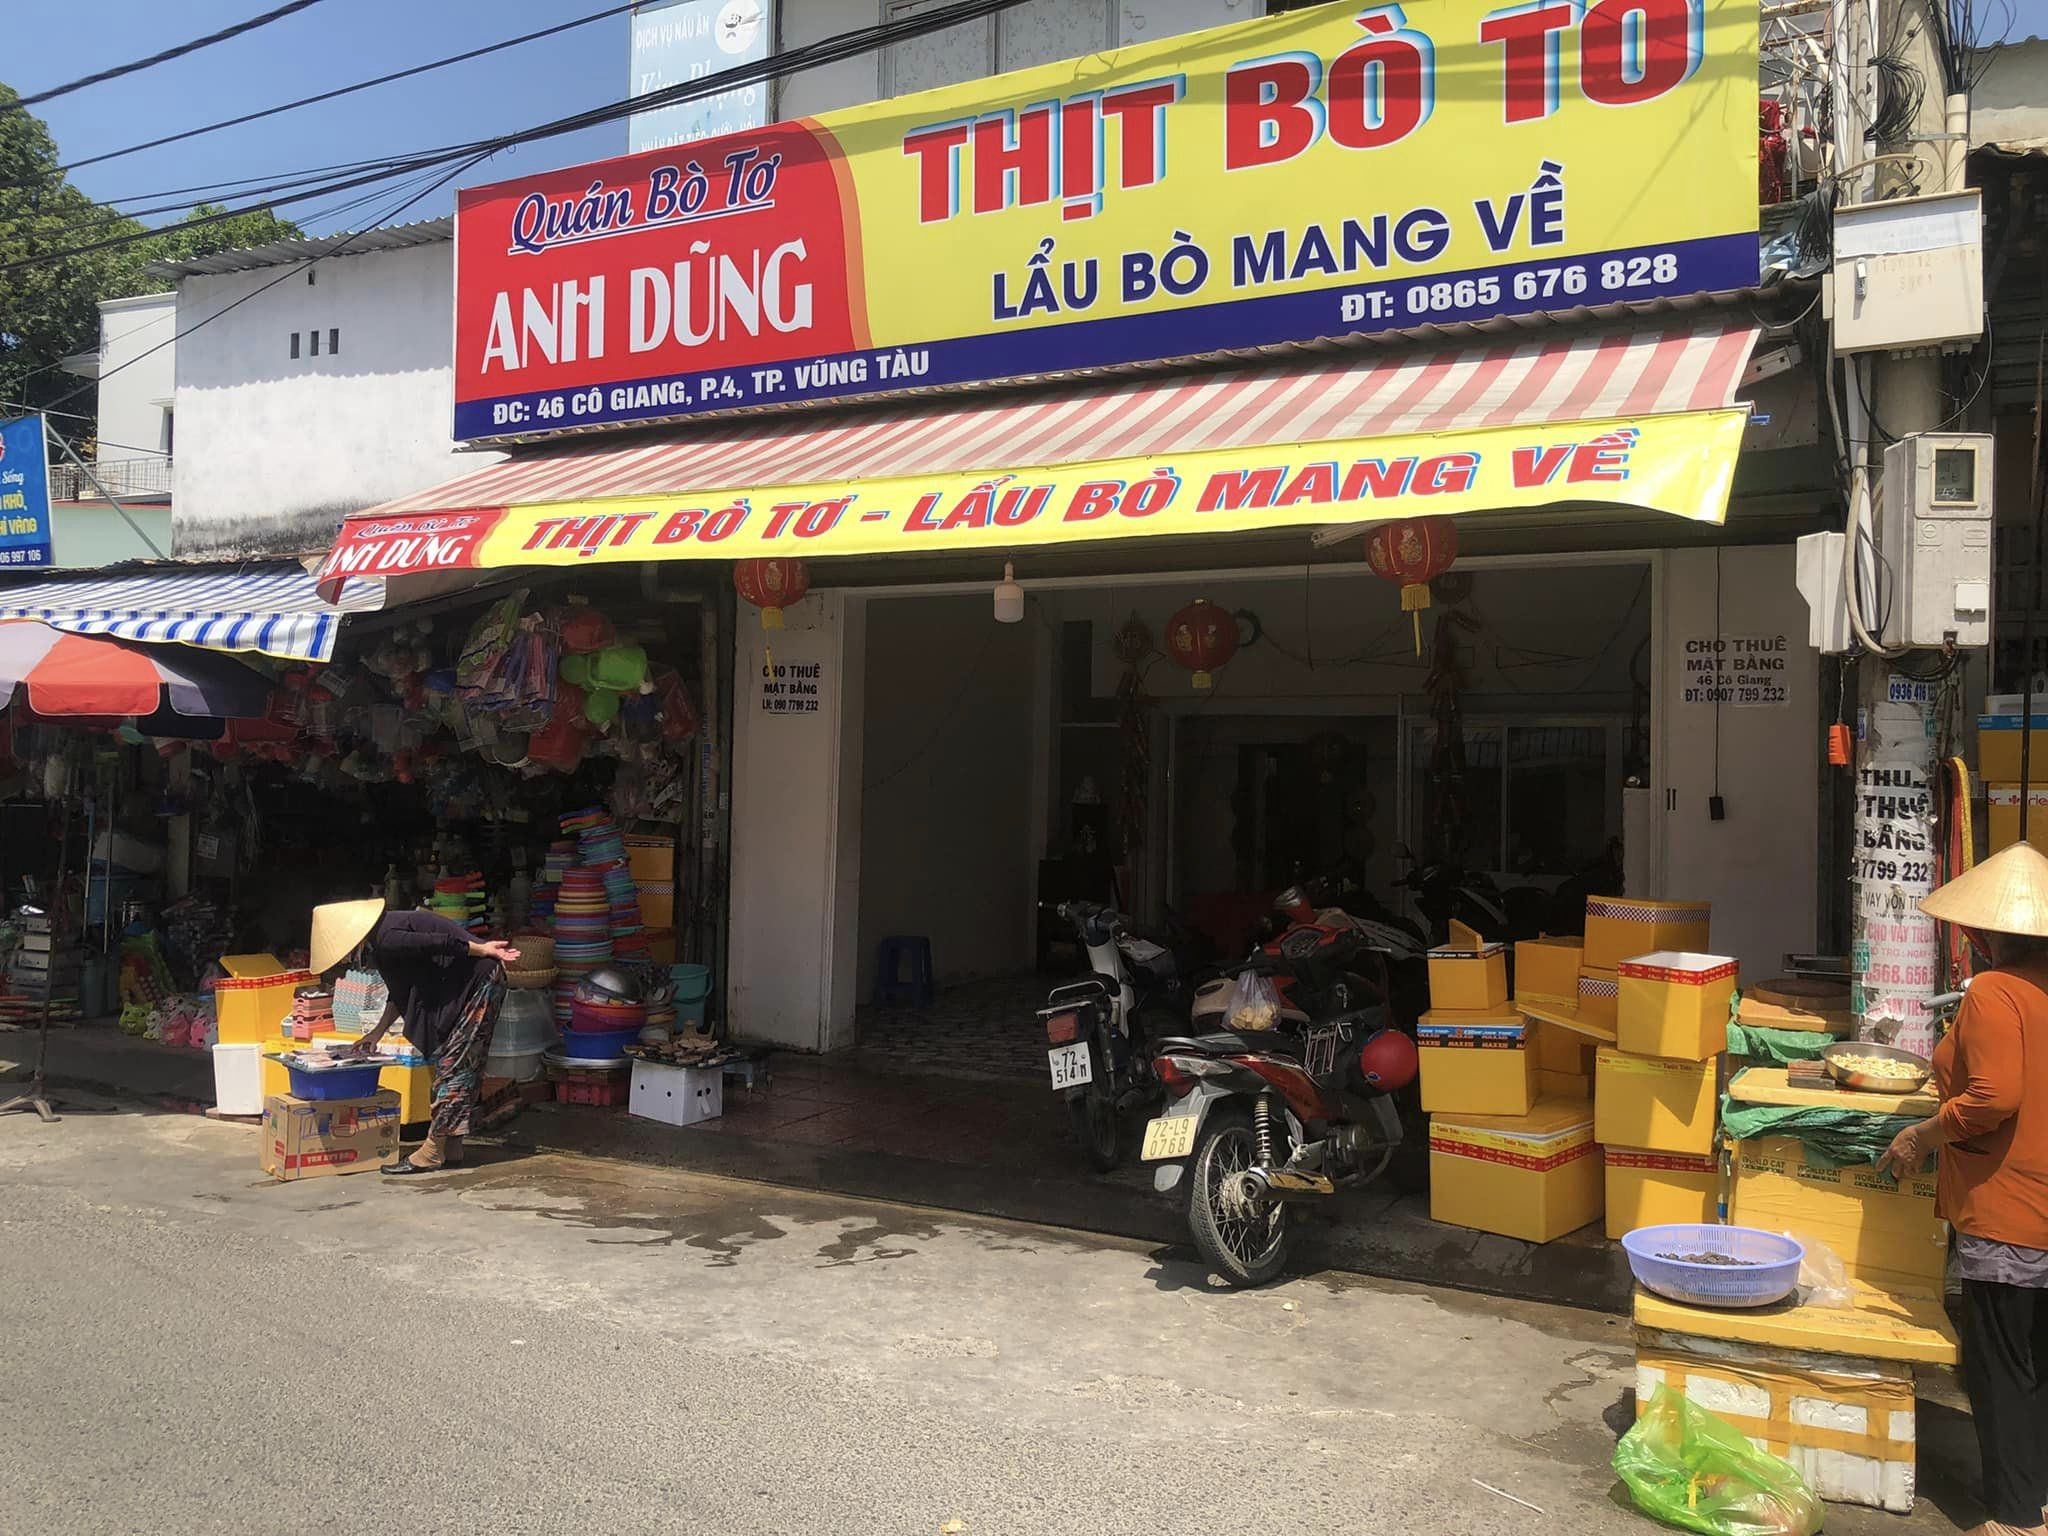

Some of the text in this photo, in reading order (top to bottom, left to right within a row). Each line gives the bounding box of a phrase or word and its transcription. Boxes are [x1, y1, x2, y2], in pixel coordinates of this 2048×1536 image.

[903, 73, 1187, 225] THỊT
[1225, 2, 1436, 172] BÒ
[512, 147, 782, 254] Quán Bò Tơ
[992, 160, 1566, 320] LẨU BÒ MANG VỀ
[1340, 253, 1678, 324] ĐT: 0865 676 828
[480, 238, 813, 375] ANH DŨNG
[493, 349, 930, 426] ĐC: 46 CÔ GIANG, P.4, TP. VŨNG TÀU
[521, 511, 658, 557] THỊT
[652, 498, 752, 545] BÒ
[761, 494, 859, 539] TƠ
[1062, 466, 1183, 523] BÒ
[1195, 451, 1482, 512] MANG
[1511, 428, 1640, 488] VỀ
[8, 514, 38, 535] VÀNG
[11, 551, 25, 562] 997
[377, 533, 472, 570] DŨNG
[1686, 635, 1787, 653] CHO THUÊ
[789, 662, 821, 678] THUÊ
[1687, 653, 1785, 674] MẶT BẰNG
[1697, 674, 1713, 685] 46
[1737, 674, 1772, 686] Giang
[1685, 687, 1785, 702] ĐT: 0907 799 232
[1889, 683, 1912, 700] 0936
[805, 700, 819, 711] 232
[1902, 861, 1928, 882] 232
[1891, 924, 1909, 943] VAY
[1062, 1051, 1078, 1068] 72
[1056, 1068, 1076, 1084] 514
[1153, 1119, 1190, 1139] 72-L9
[1149, 1137, 1186, 1157] 0768
[1770, 1160, 1786, 1168] CAT
